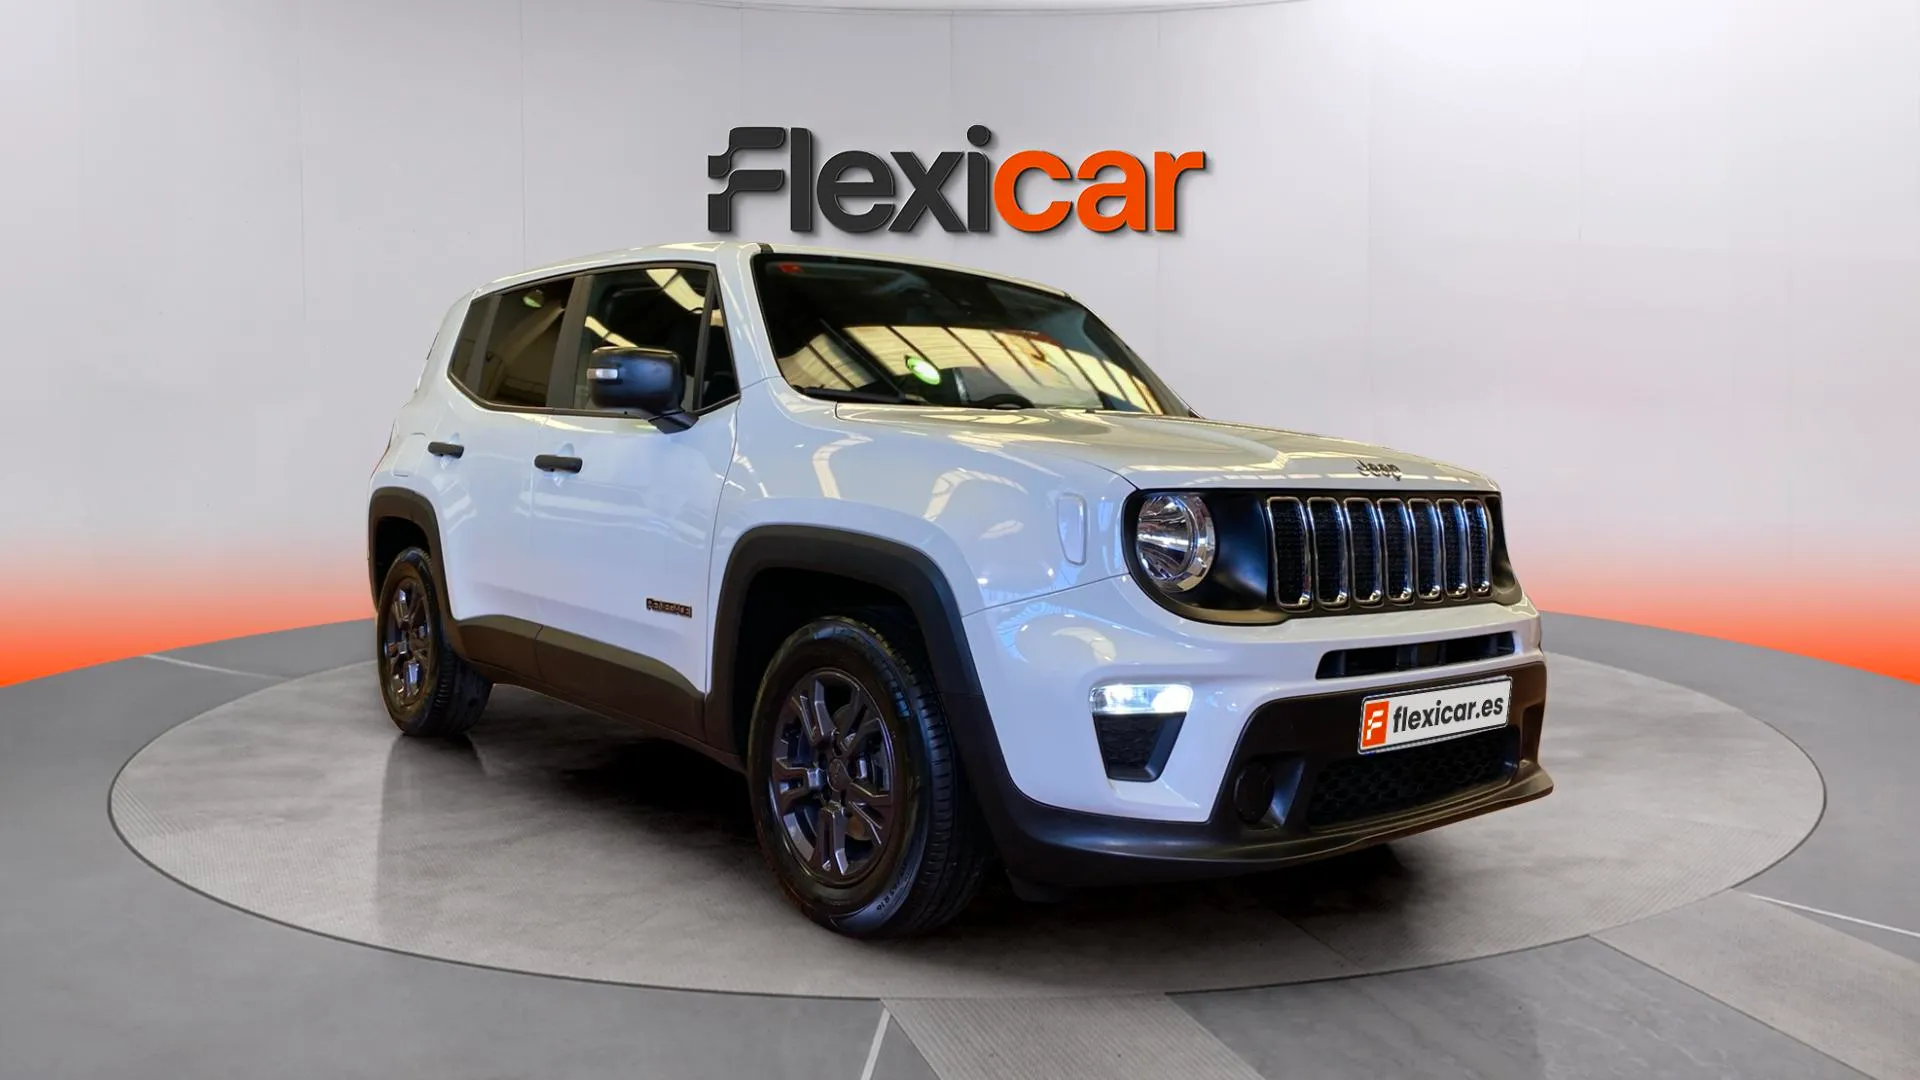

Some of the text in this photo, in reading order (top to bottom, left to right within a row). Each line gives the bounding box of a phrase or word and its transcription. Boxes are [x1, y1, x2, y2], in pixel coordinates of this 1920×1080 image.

[707, 124, 1205, 232] Flexicar
[1355, 458, 1401, 481] Jeep
[1392, 696, 1504, 734] flexicar.es
